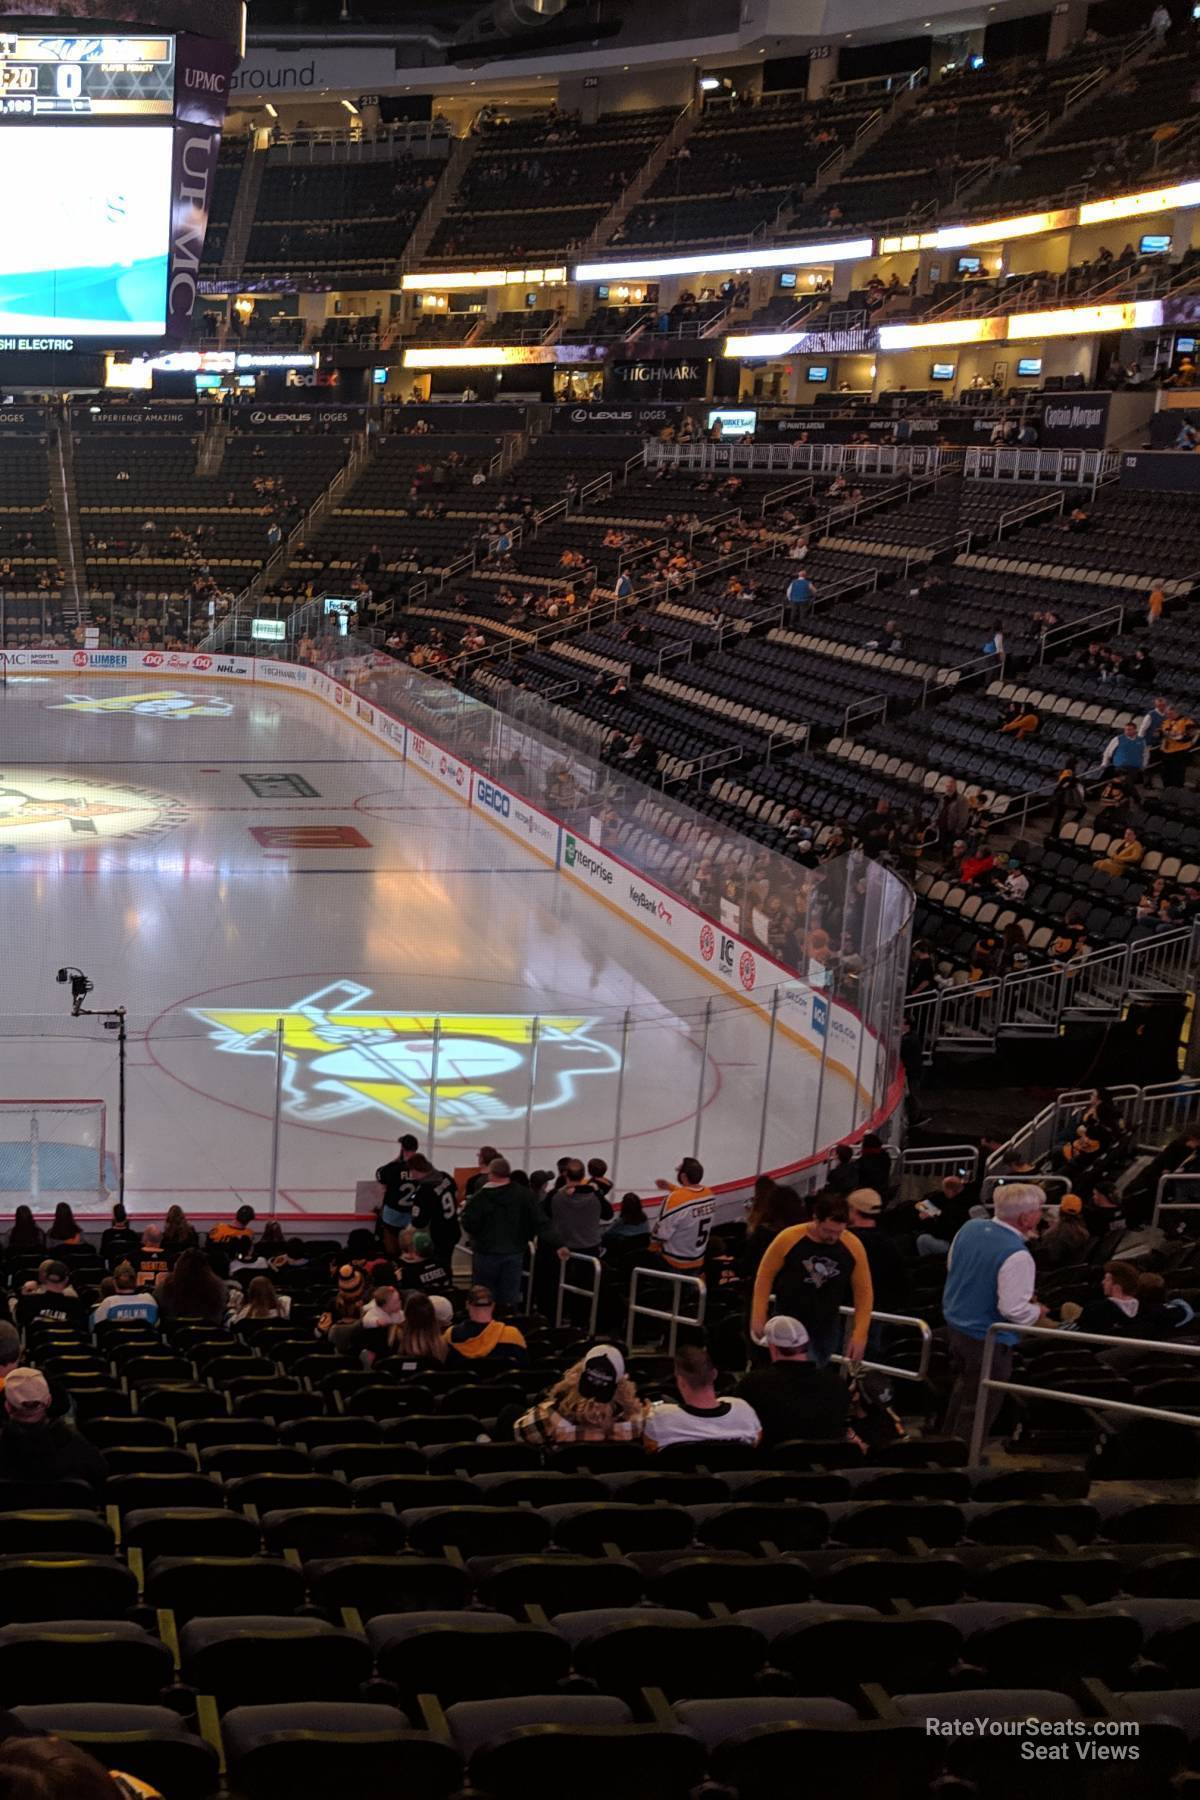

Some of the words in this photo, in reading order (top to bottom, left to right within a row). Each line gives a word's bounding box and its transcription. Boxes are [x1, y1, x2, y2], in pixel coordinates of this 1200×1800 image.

[810, 48, 829, 60] 215
[57, 64, 82, 97] 0
[185, 68, 225, 93] UPMC
[168, 135, 212, 317] UPMC
[18, 338, 74, 351] ELECTRIC
[286, 369, 340, 387] FedEx
[623, 366, 700, 381] HIGHMARK
[92, 414, 144, 423] EXPERIENCE
[145, 414, 184, 423] AMAZING
[267, 414, 311, 422] LEXUS
[319, 412, 348, 422] LOGES
[588, 411, 632, 420] LEXUS
[639, 410, 666, 421] LOGES
[1044, 405, 1071, 428] Captain
[1070, 406, 1103, 429] Morgan
[981, 455, 993, 468] 111
[1064, 457, 1077, 471] 111
[89, 655, 128, 665] LUMBER
[477, 779, 510, 818] GEICO
[567, 845, 613, 885] enterprise
[629, 884, 658, 917] KeyBank
[720, 935, 735, 967] IC
[814, 1007, 827, 1026] IGS
[696, 1217, 712, 1248] 5
